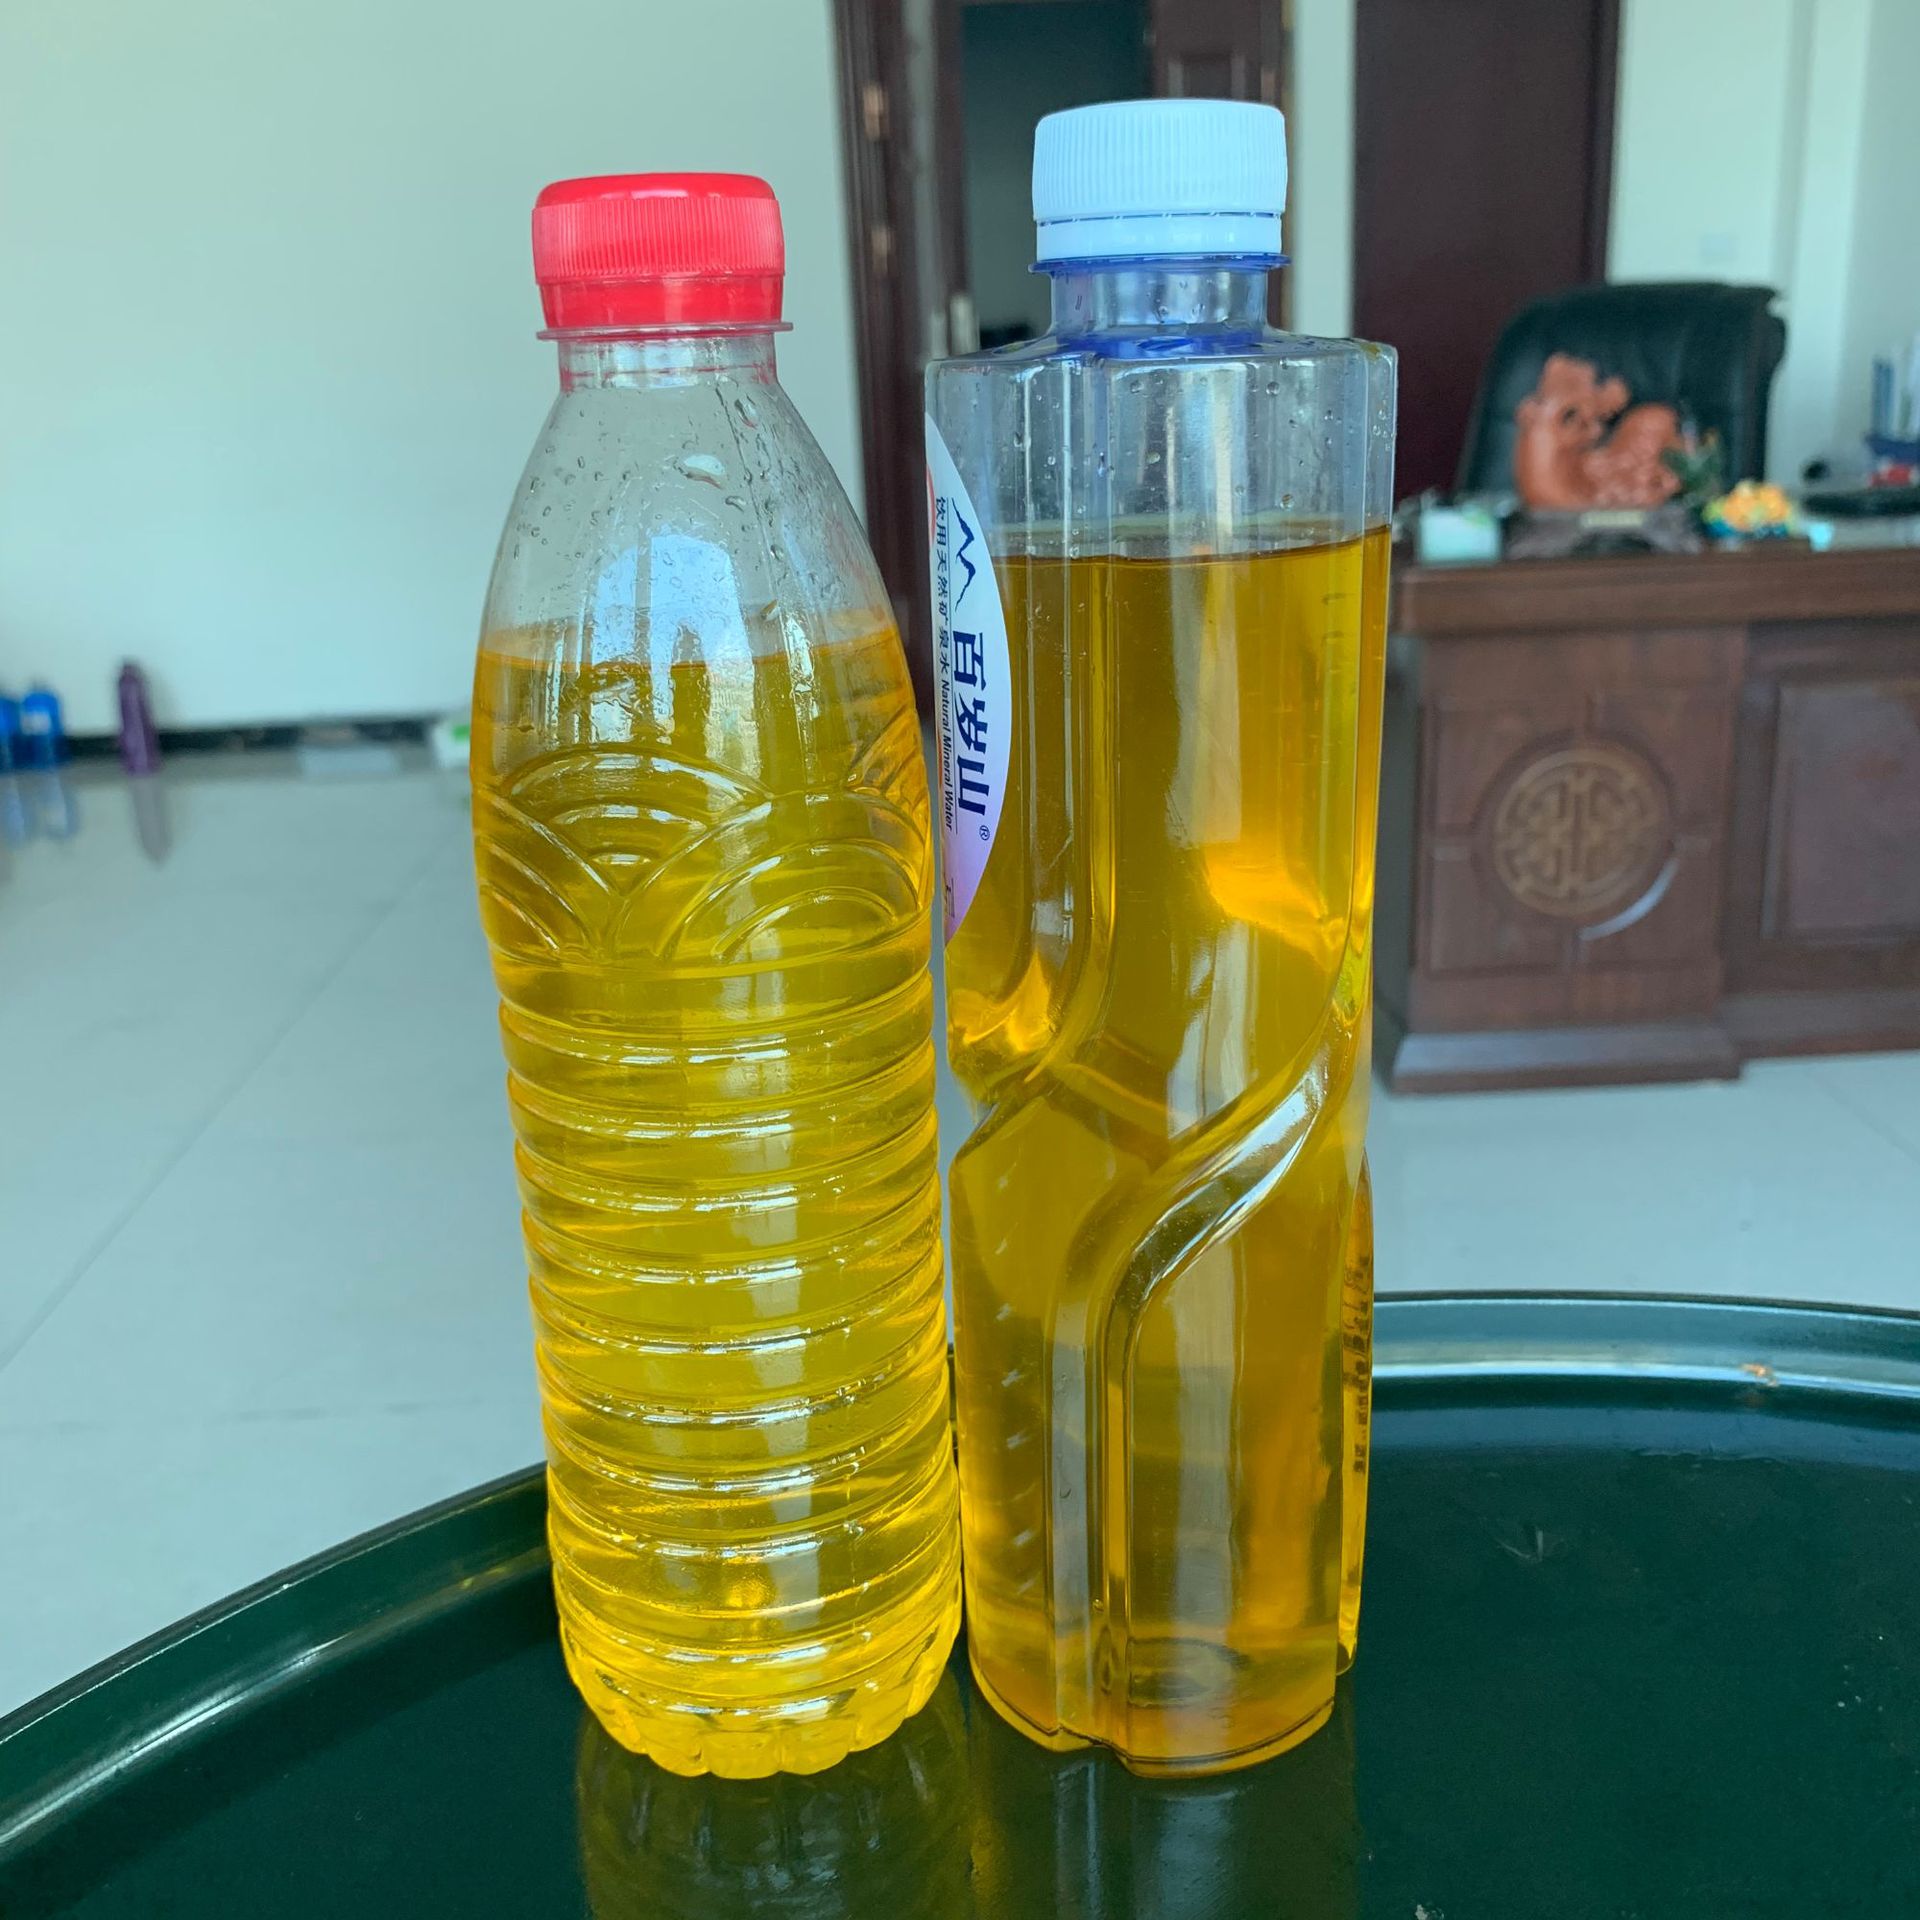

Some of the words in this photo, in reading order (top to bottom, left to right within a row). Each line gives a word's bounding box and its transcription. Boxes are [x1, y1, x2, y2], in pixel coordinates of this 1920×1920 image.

[936, 496, 950, 673] 饮用天然矿泉水
[941, 679, 952, 732] Natural
[953, 631, 989, 816] 百岁山
[942, 735, 953, 787] Mineral
[944, 789, 955, 831] Water
